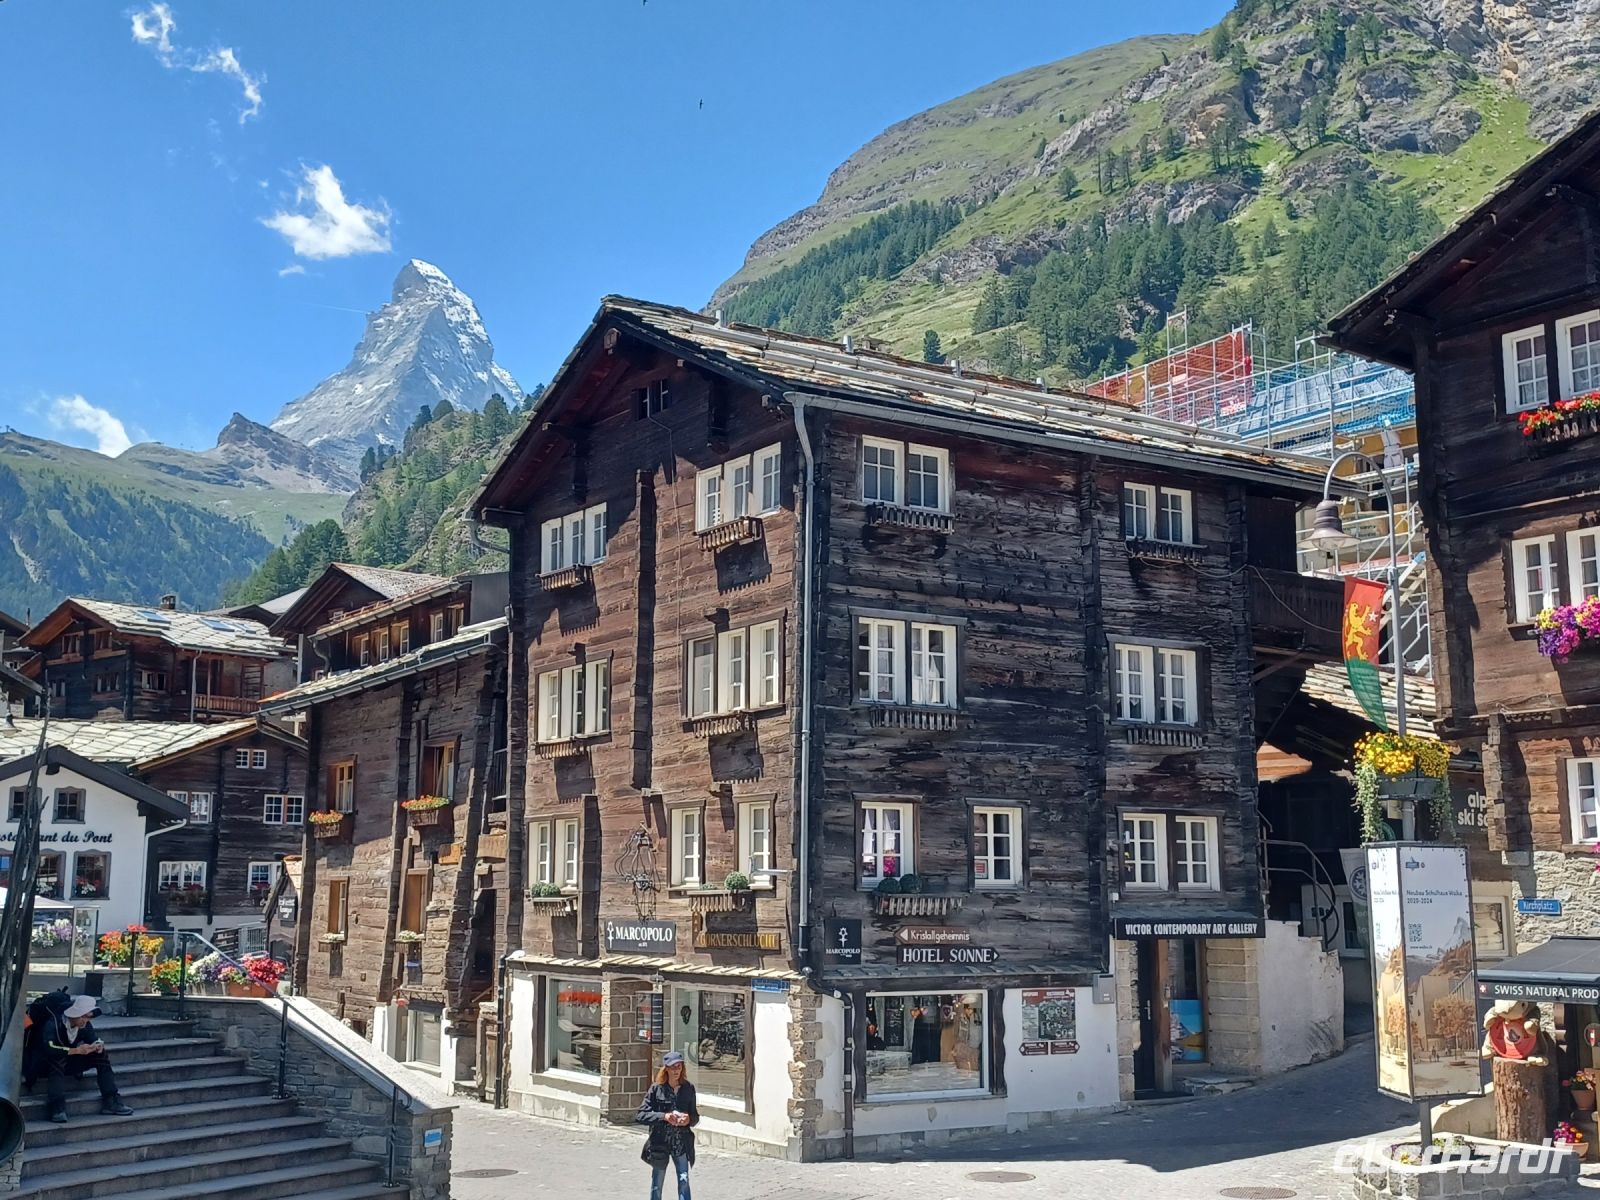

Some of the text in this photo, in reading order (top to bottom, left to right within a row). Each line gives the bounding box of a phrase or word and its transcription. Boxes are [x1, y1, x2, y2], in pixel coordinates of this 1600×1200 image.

[1467, 791, 1488, 812] alp
[1457, 808, 1489, 827] ski sc
[61, 830, 79, 843] du
[83, 830, 113, 843] Pont
[615, 926, 673, 942] MARCOPOLO
[910, 929, 971, 943] Kristallgeheimnis
[1125, 923, 1258, 935] VICTOR CONTEMPORARY ART GALLERY
[902, 948, 992, 963] HOTEL SONNE
[1494, 984, 1600, 999] SWISS NATURAL PROD
